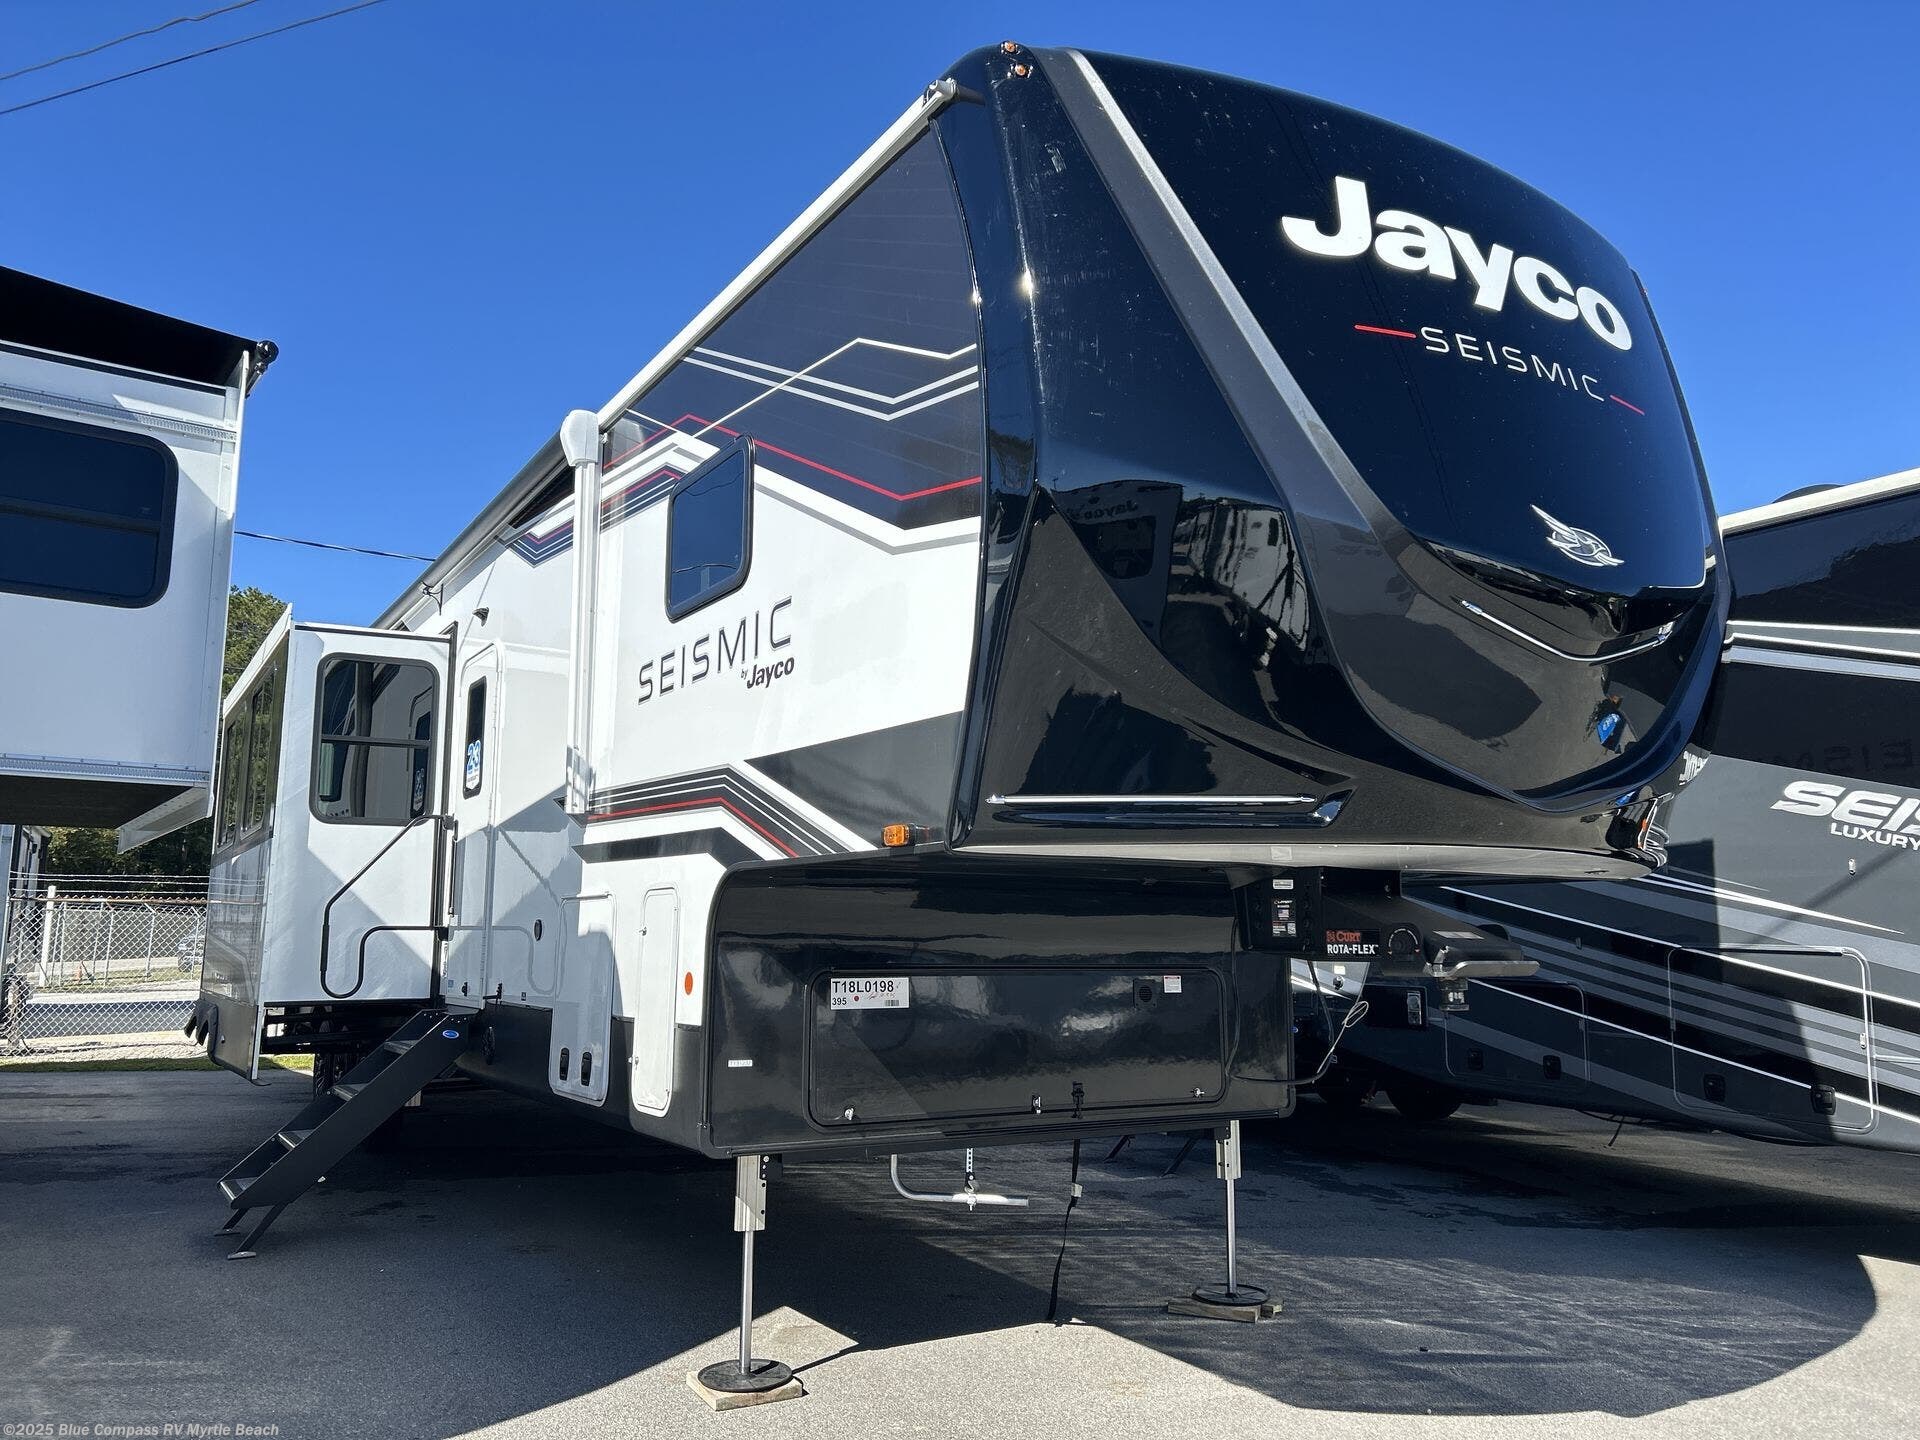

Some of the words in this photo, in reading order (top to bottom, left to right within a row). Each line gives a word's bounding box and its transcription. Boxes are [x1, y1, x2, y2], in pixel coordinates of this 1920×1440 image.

[1282, 176, 1632, 351] Jayco
[1421, 326, 1605, 402] SEISMIC
[638, 596, 793, 706] SEISMIC
[747, 657, 795, 689] Jayco
[1770, 780, 1920, 835] SEI
[1830, 822, 1920, 850] LUXURY
[832, 981, 894, 993] T18L0198
[832, 997, 848, 1006] 395
